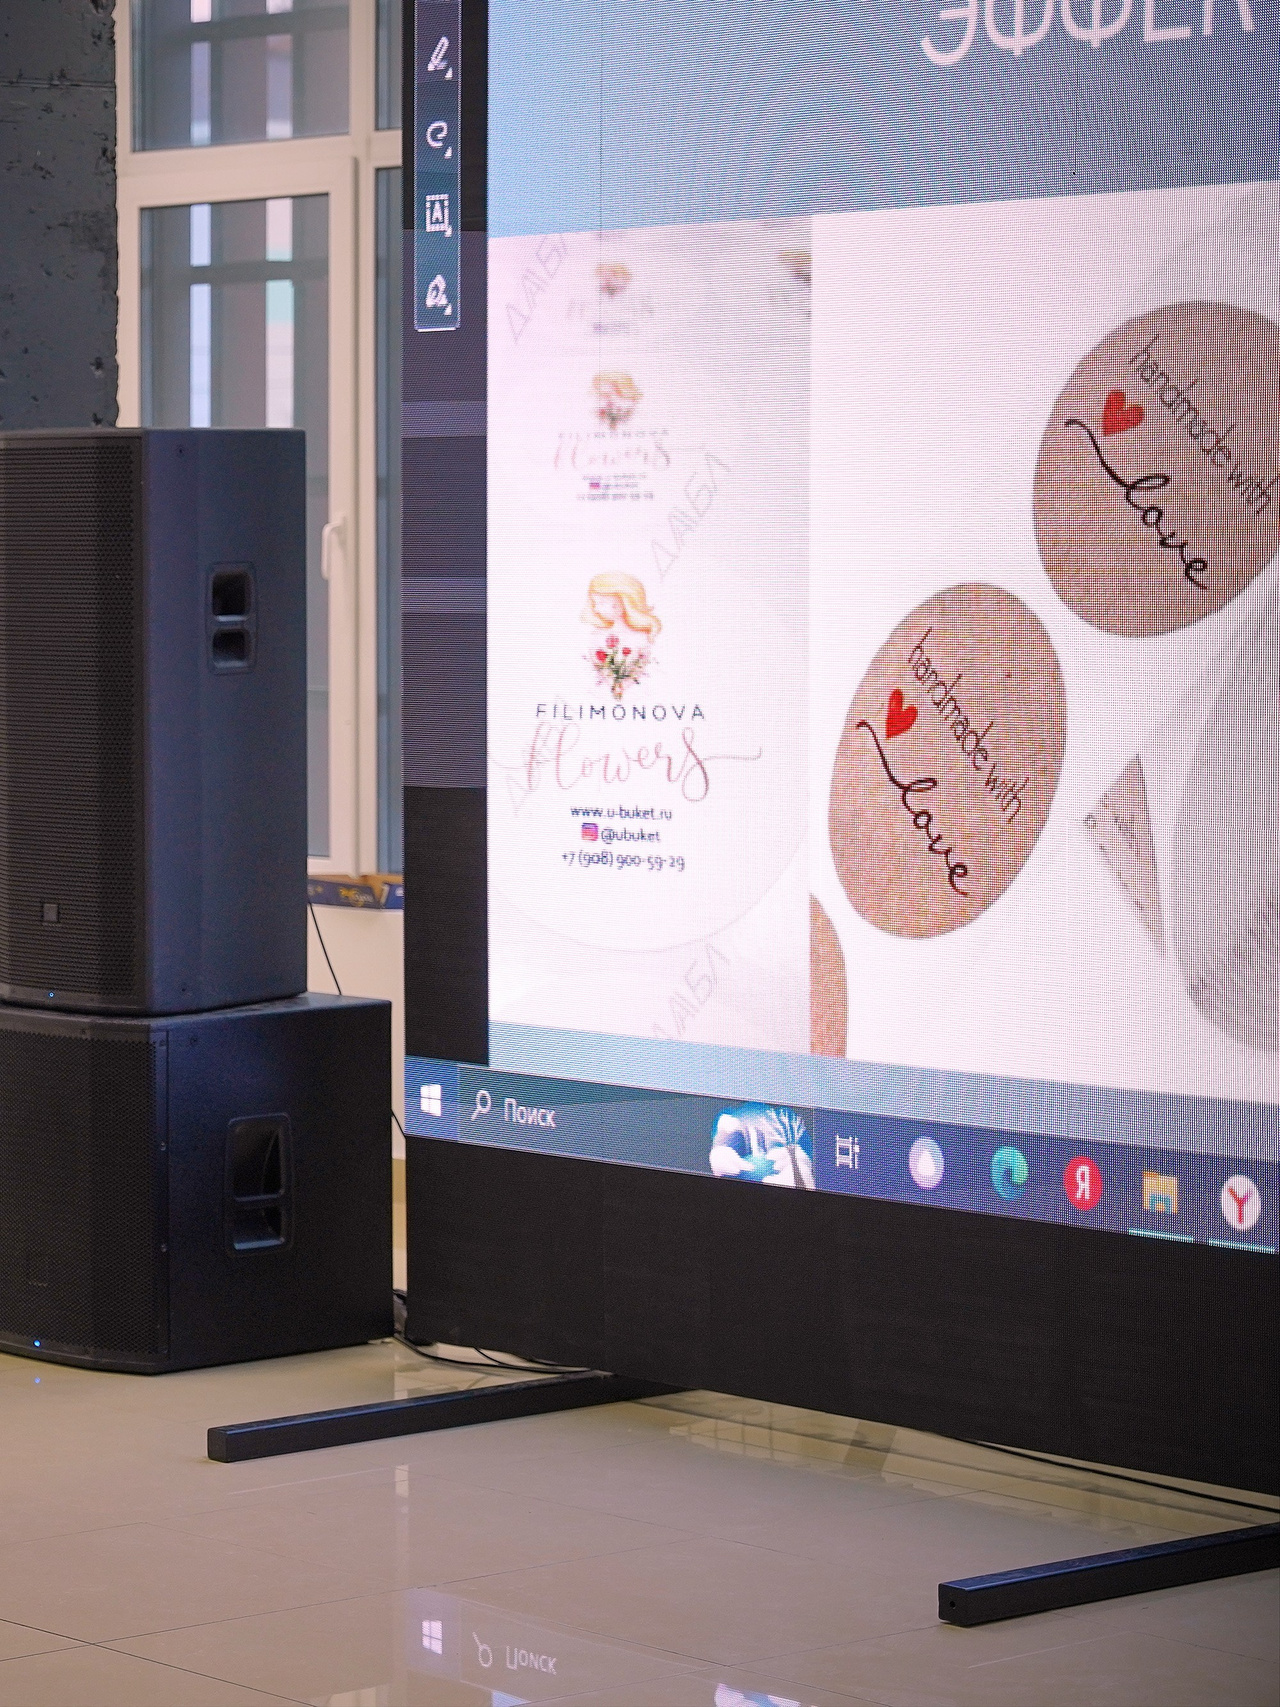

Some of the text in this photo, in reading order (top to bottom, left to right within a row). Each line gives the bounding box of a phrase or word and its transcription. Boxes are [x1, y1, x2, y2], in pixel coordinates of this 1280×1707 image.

[1130, 334, 1280, 515] handmade with
[1064, 418, 1208, 590] love
[535, 703, 706, 722] FILIMONOVA
[908, 626, 1030, 824] handmade with
[492, 721, 762, 803] flowers
[570, 804, 673, 820] www.u-buket.ru
[601, 826, 661, 845] @ubuket
[855, 719, 970, 897] love
[561, 851, 576, 867] +7
[578, 850, 614, 868] (908)
[504, 1097, 557, 1129] Поиск
